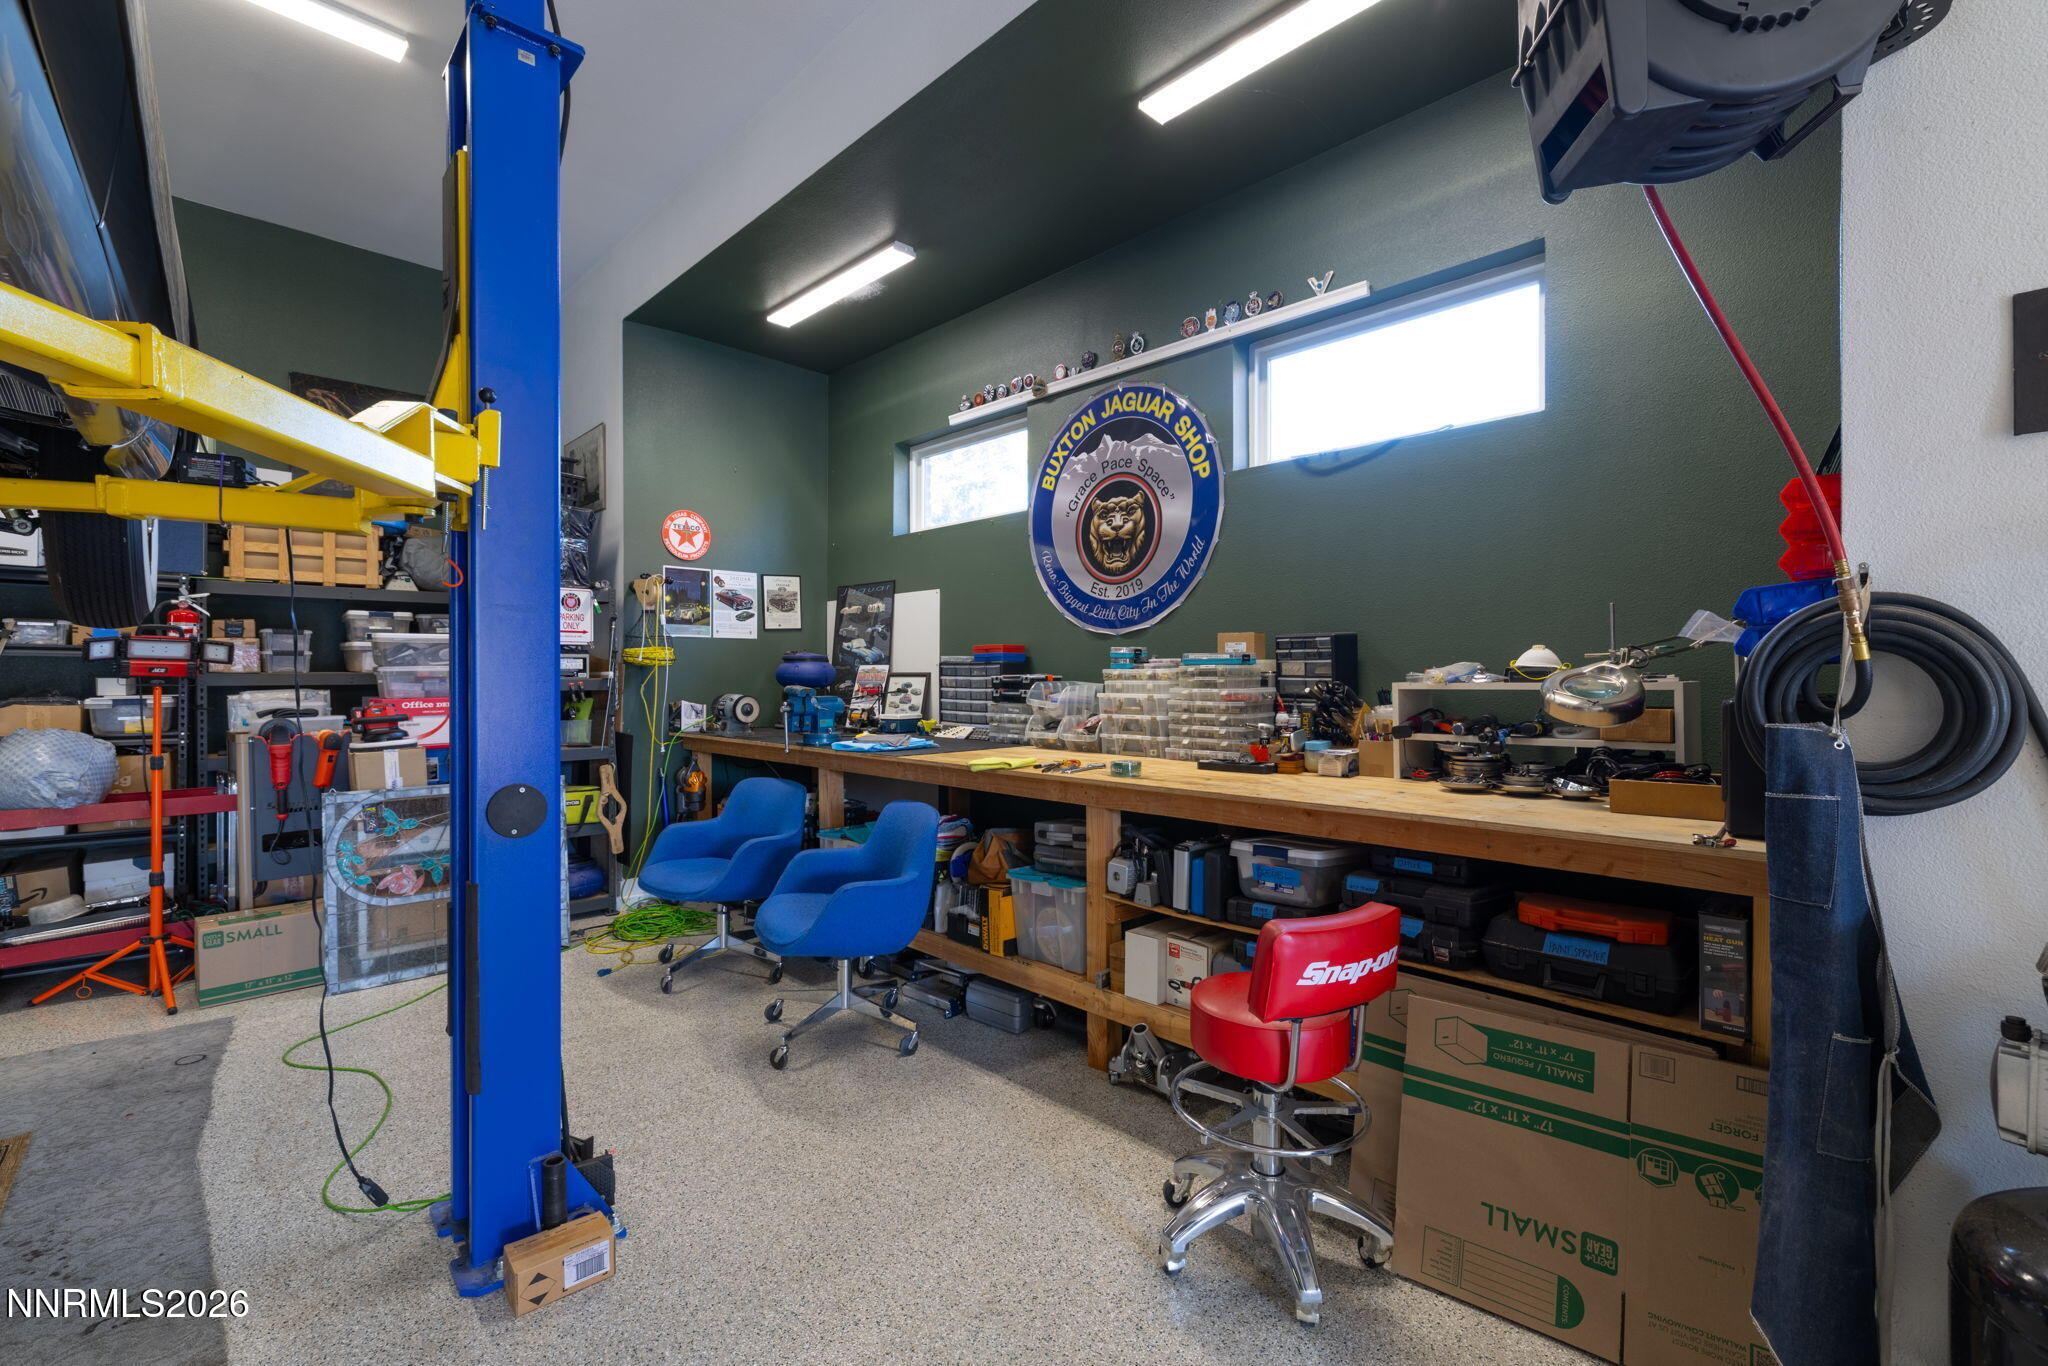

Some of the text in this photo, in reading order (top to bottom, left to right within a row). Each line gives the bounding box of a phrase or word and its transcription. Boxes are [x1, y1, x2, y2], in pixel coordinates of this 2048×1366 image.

[1042, 392, 1211, 491] BUXTON JAGUAR SHOP
[1101, 458, 1133, 473] Pace
[673, 523, 701, 532] TEXACO
[1058, 580, 1089, 614] Biggest
[1088, 604, 1118, 620] Little
[1117, 605, 1141, 621] City
[1141, 596, 1159, 612] In
[1156, 578, 1180, 602] The
[1175, 534, 1206, 579] World
[1090, 578, 1144, 598] Est. 2019
[562, 621, 580, 630] ONLY
[401, 701, 434, 710] Office
[226, 924, 283, 943] SMALL
[1703, 935, 1745, 946] HEAT GUN
[1296, 945, 1399, 985] Snap-on
[1509, 1039, 1576, 1062] 17" x 11" x 12"
[1545, 1065, 1585, 1083] SMALL
[1468, 1100, 1553, 1133] 17" x 11" x 12"
[1709, 1122, 1760, 1142] FORGET
[1481, 1200, 1577, 1254] SMALL
[1585, 1238, 1613, 1259] GEAR
